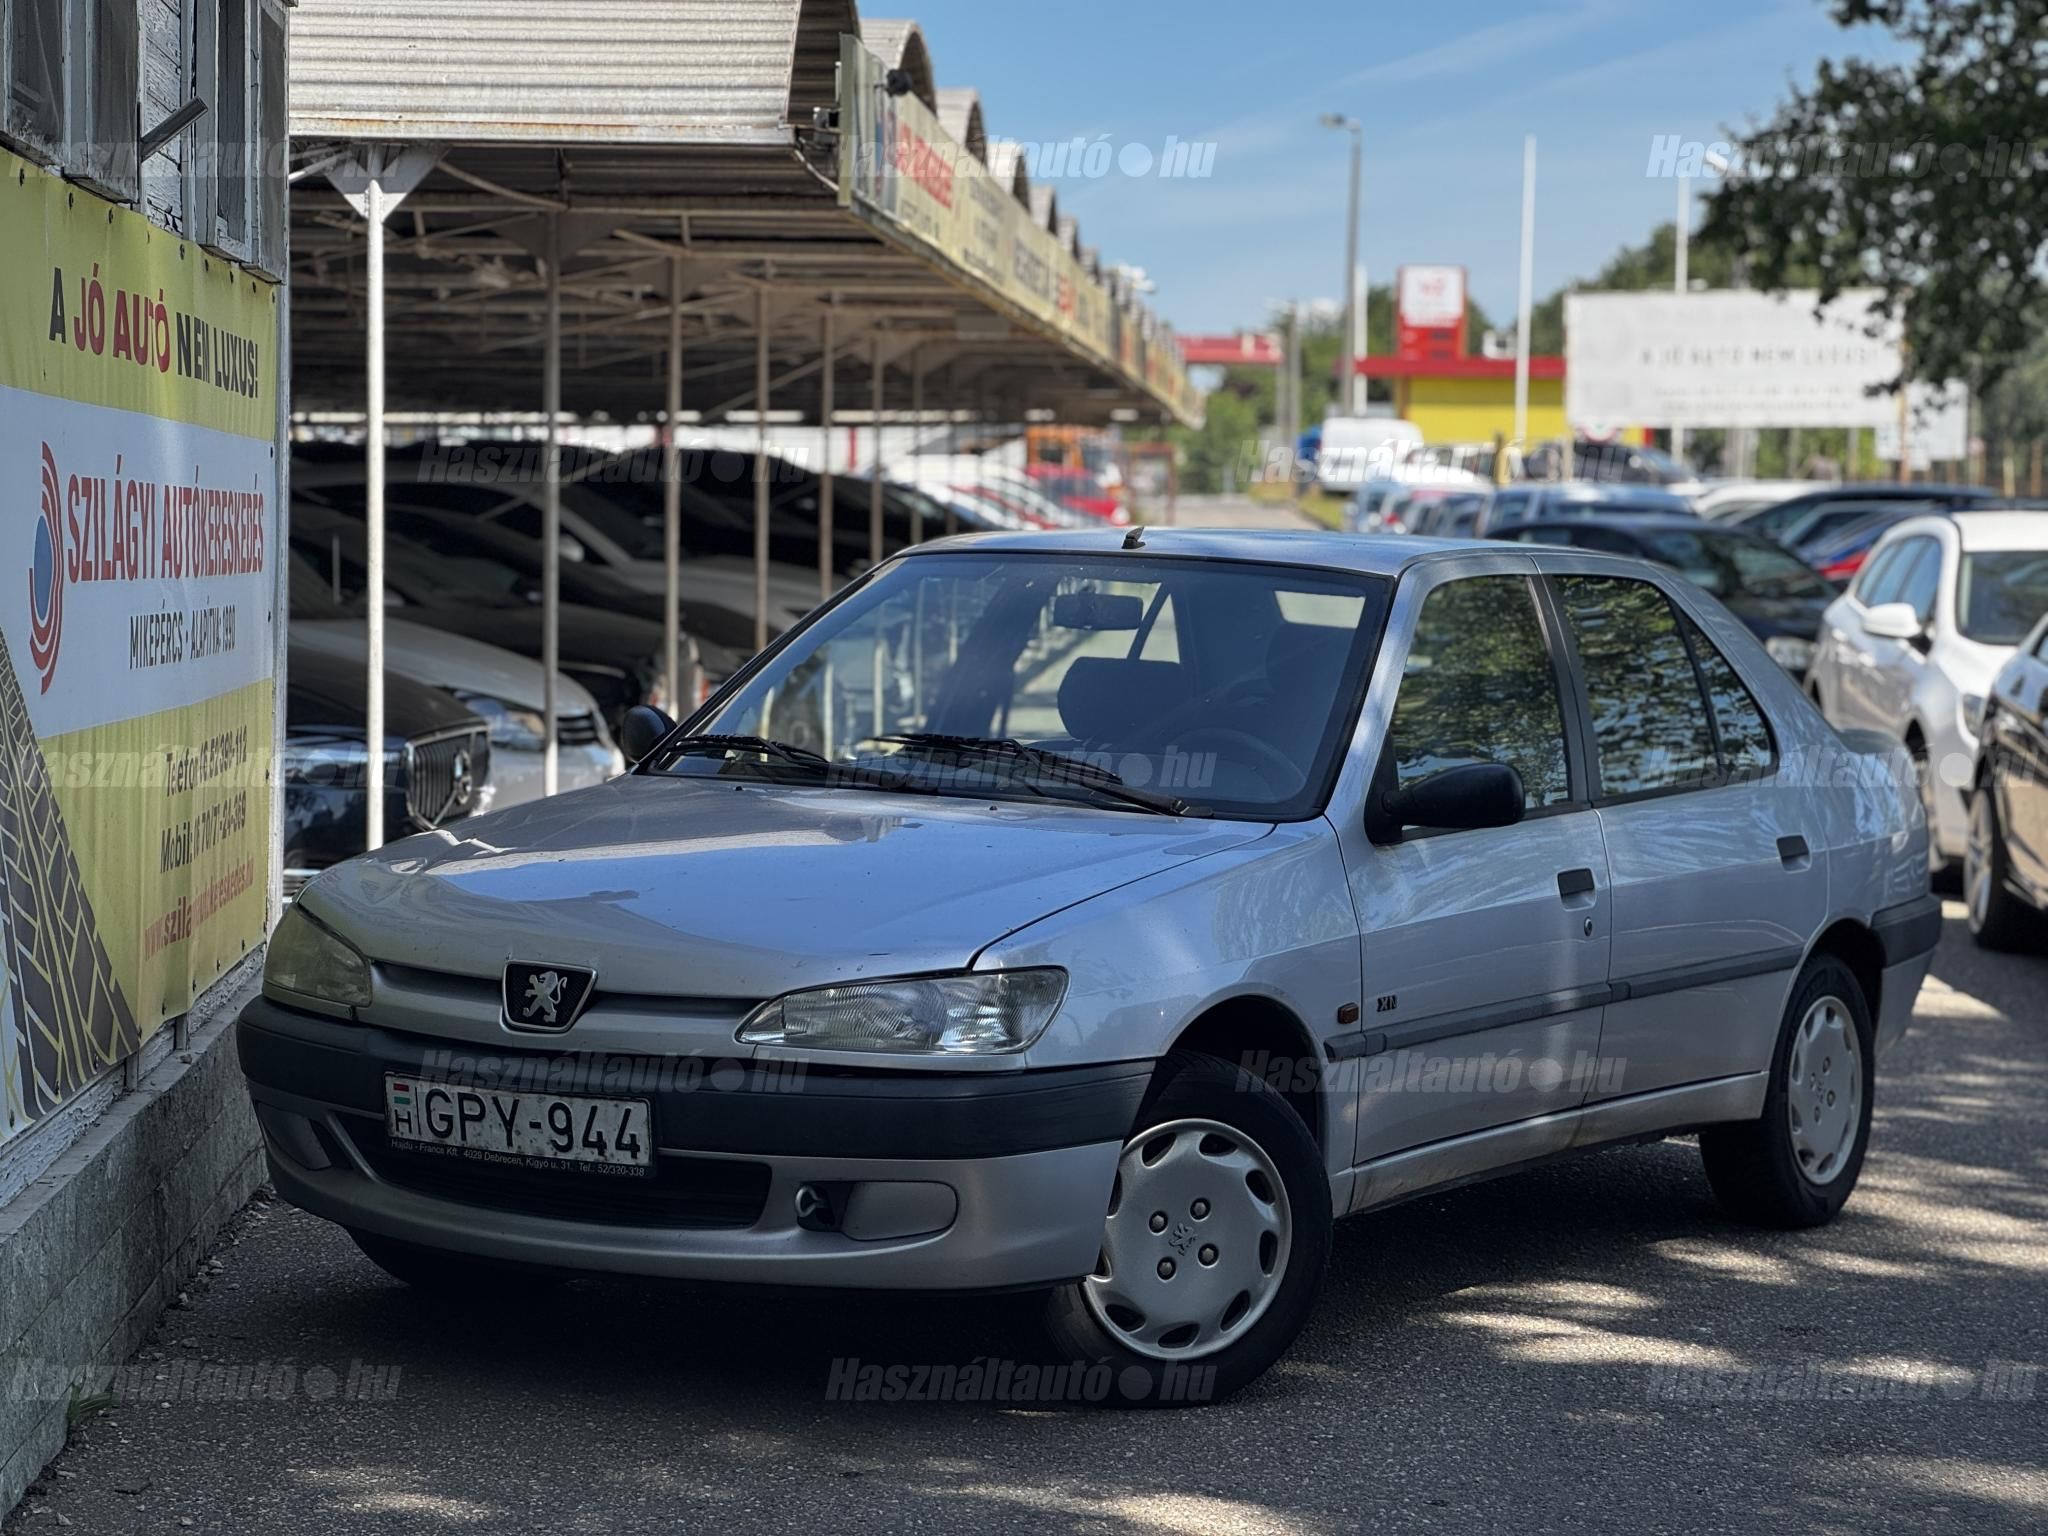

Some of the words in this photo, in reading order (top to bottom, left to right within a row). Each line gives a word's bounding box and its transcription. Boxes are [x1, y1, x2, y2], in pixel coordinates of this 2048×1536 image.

[49, 267, 66, 345] A
[73, 262, 105, 356] JÓ
[113, 287, 170, 374] AUTÓ
[176, 312, 211, 385] NEM
[213, 327, 259, 399] LUXUS!
[67, 454, 156, 583] SZILÁGYI
[161, 464, 264, 579] AUTÓKERESKEDÉS
[129, 599, 183, 671] MIKEPÉRCS
[160, 821, 193, 874] Mobil:
[394, 1109, 413, 1134] H
[419, 1143, 445, 1154] France
[425, 1087, 641, 1159] GPY-944
